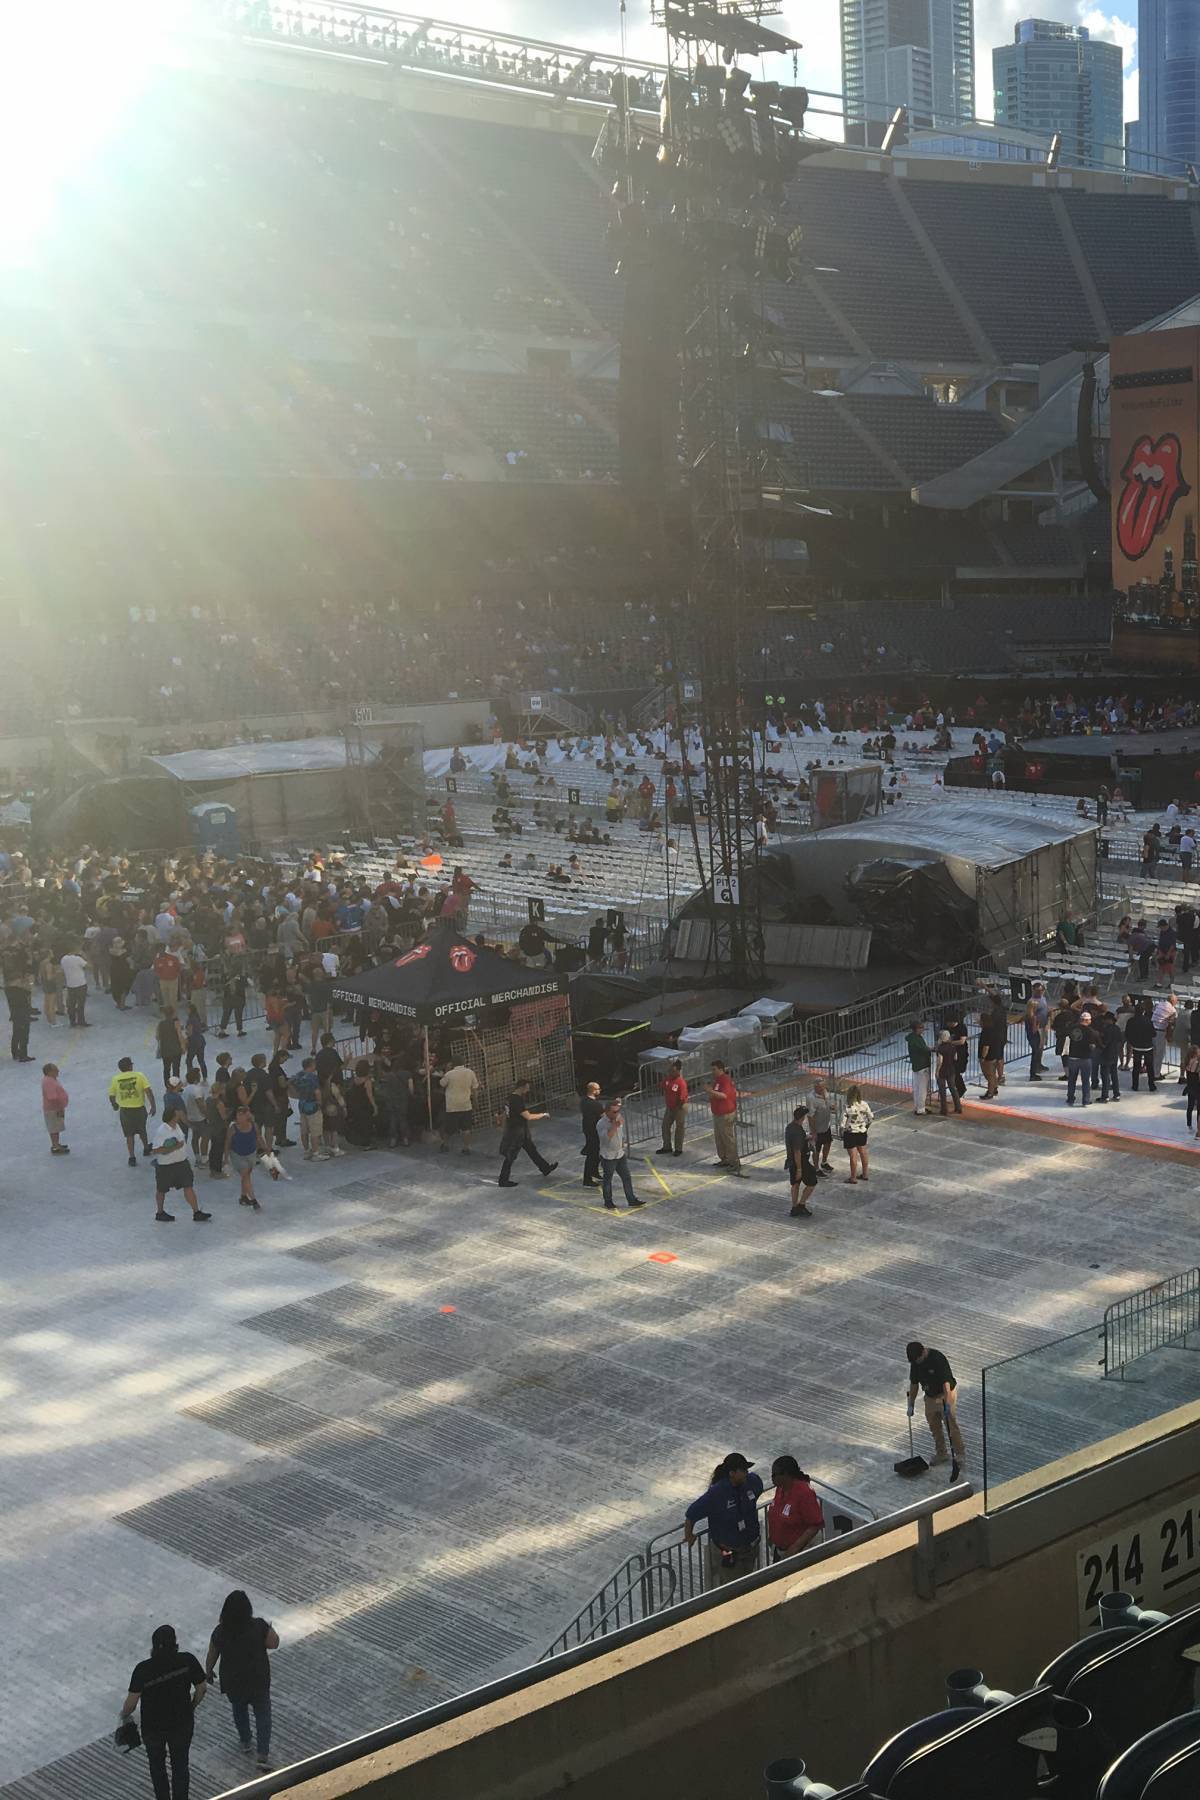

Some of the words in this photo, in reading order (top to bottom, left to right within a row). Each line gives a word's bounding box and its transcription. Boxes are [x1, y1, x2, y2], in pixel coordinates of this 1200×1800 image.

[447, 778, 456, 793] G
[571, 789, 579, 803] G
[716, 878, 730, 887] PIT
[731, 879, 737, 888] 2
[532, 901, 540, 917] K
[434, 997, 486, 1018] OFFICIAL
[491, 981, 559, 1005] MERCHANDISE
[1017, 982, 1026, 1000] J
[332, 989, 365, 1006] OFFICIAL
[368, 996, 417, 1018] MERCHANDISE
[1084, 1533, 1144, 1611] 214
